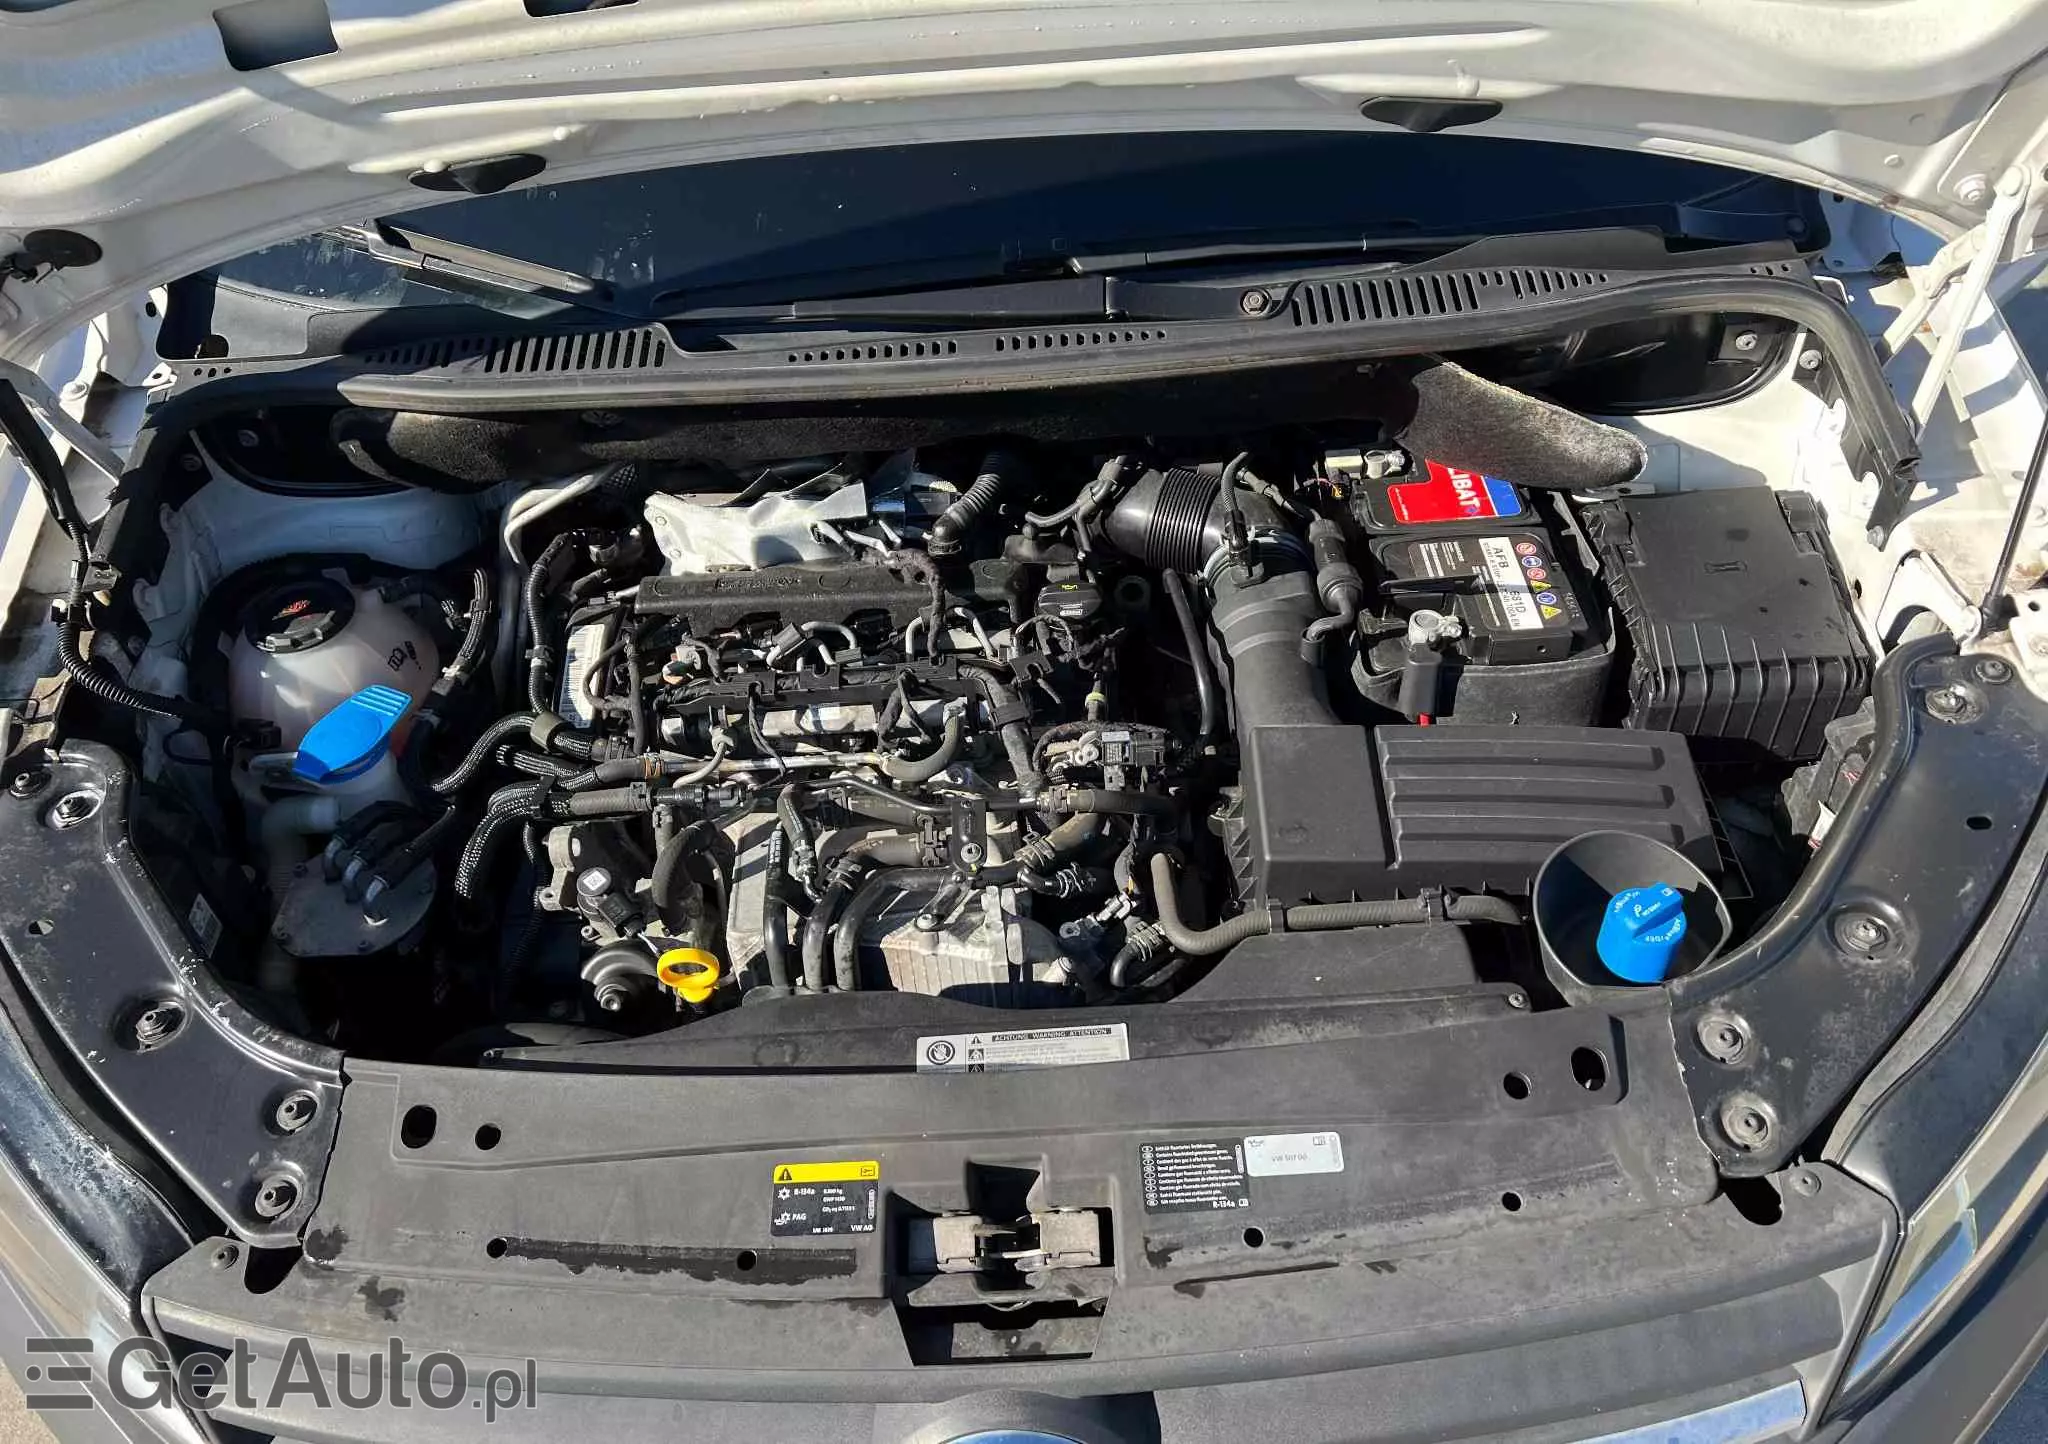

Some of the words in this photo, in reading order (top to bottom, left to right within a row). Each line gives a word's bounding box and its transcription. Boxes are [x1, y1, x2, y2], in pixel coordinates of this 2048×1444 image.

[994, 1033, 1025, 1041] ACHTUNG
[1032, 1031, 1066, 1039] WARNING
[1068, 1027, 1107, 1037] ATTENTION
[1212, 1199, 1236, 1208] R-134a
[792, 1213, 807, 1221] PAG
